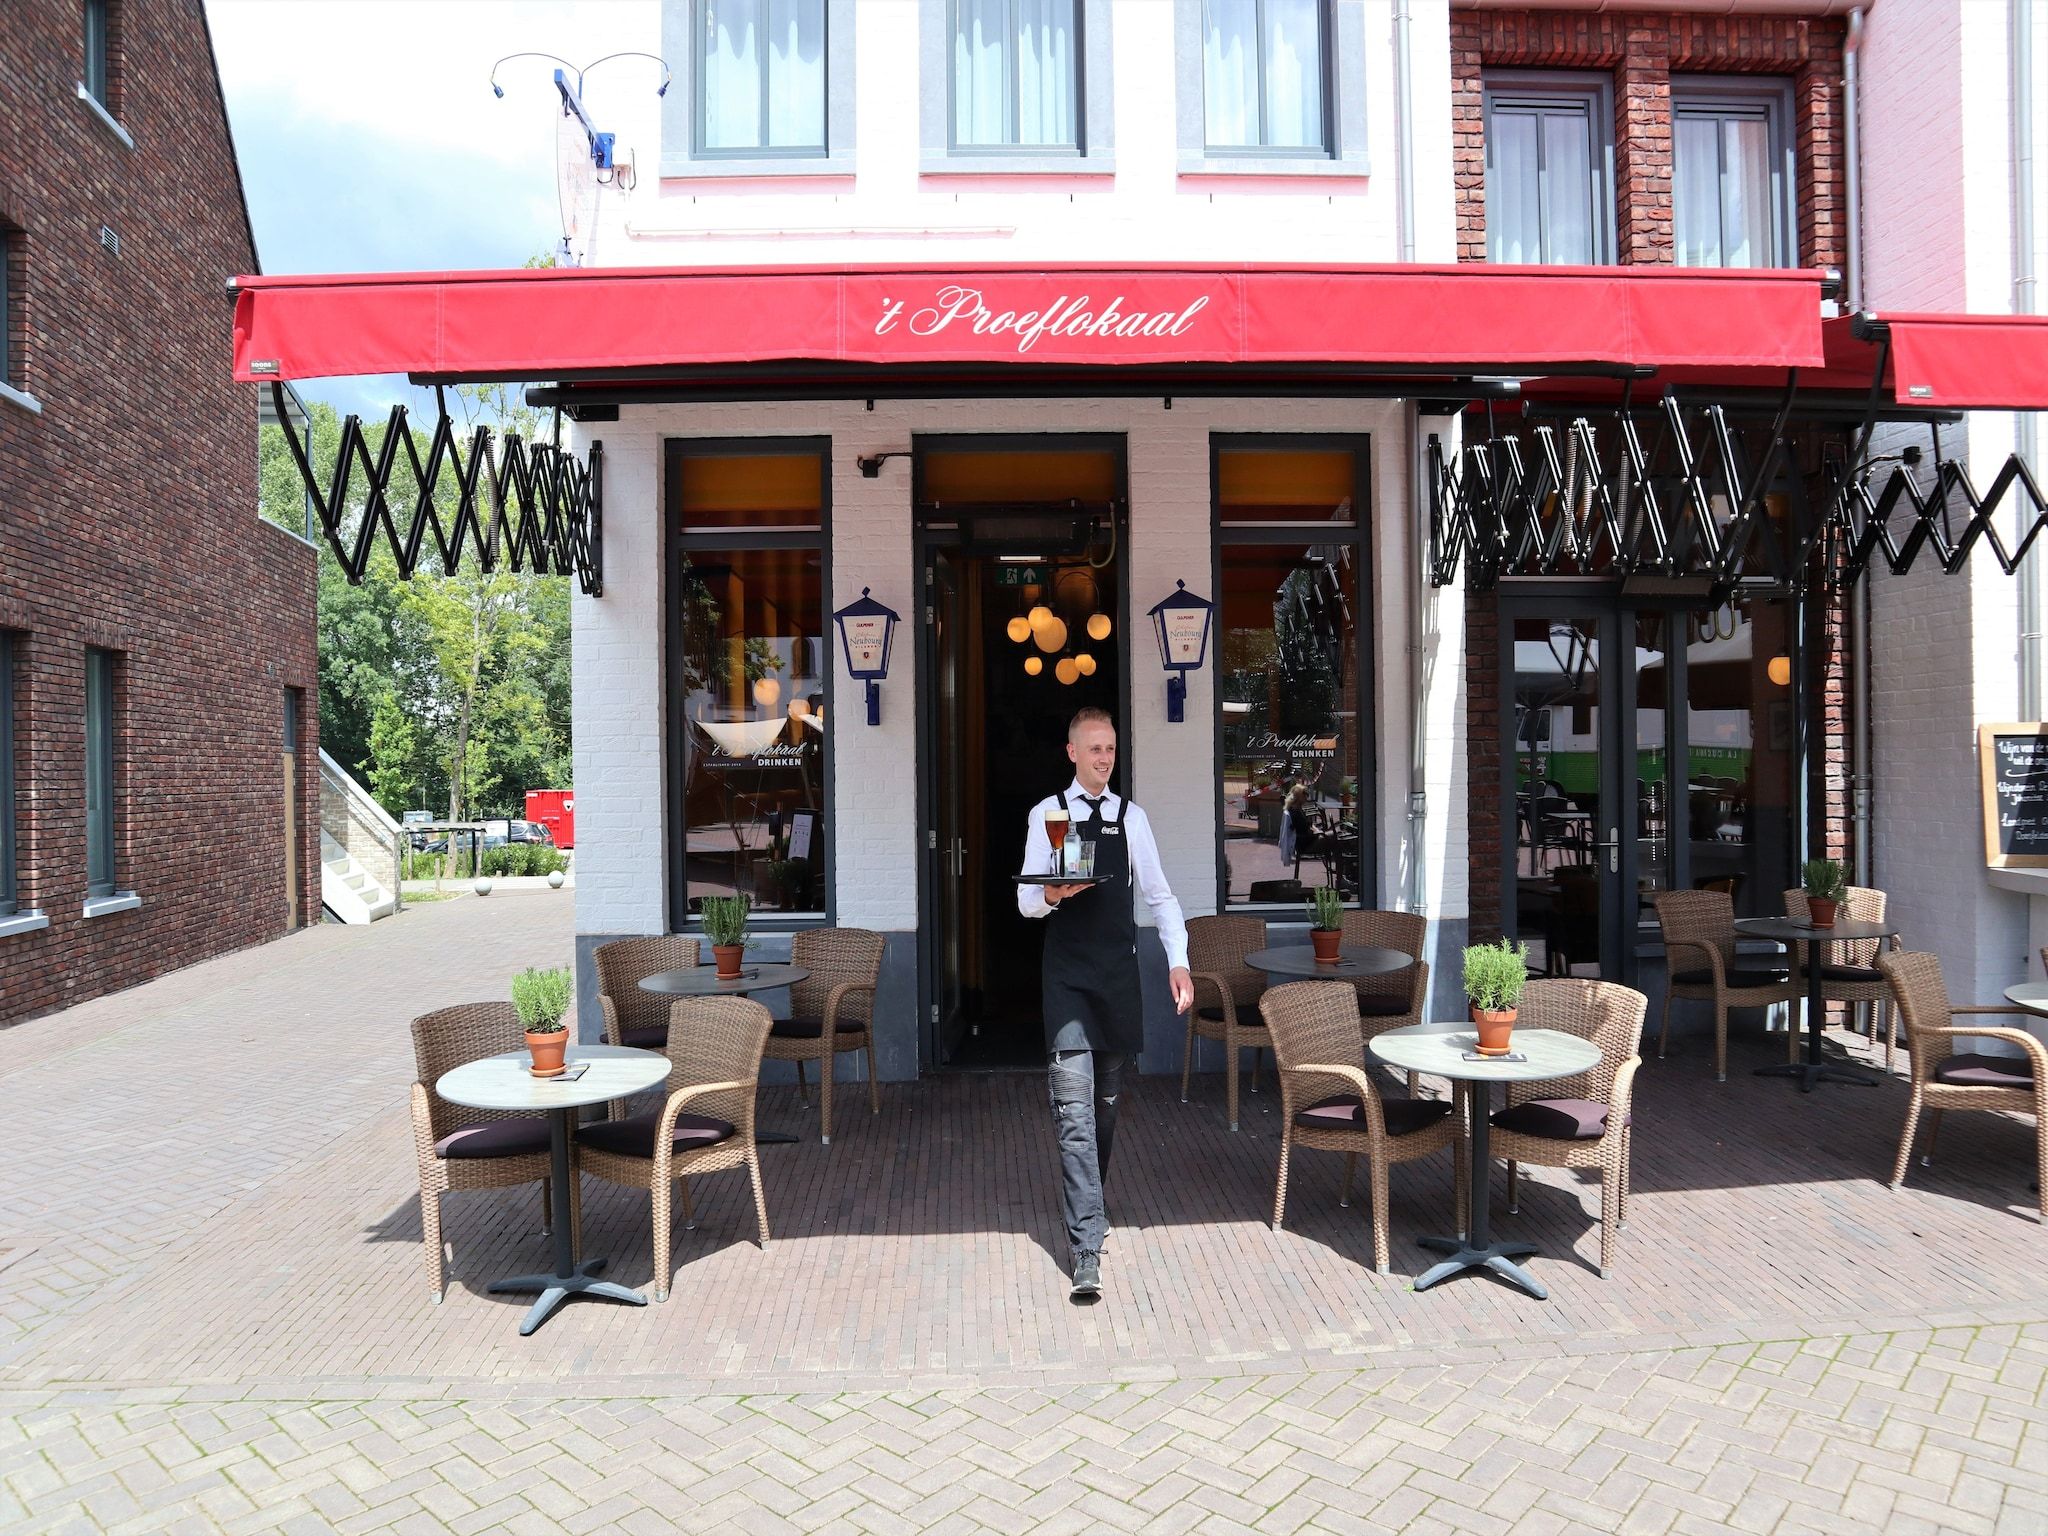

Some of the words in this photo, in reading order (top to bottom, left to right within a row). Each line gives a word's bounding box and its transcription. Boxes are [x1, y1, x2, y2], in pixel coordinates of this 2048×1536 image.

[874, 297, 905, 336] 't
[909, 285, 1210, 353] Proeflokaal
[1291, 749, 1335, 758] DRINKEN
[757, 758, 802, 767] DRINKEN
